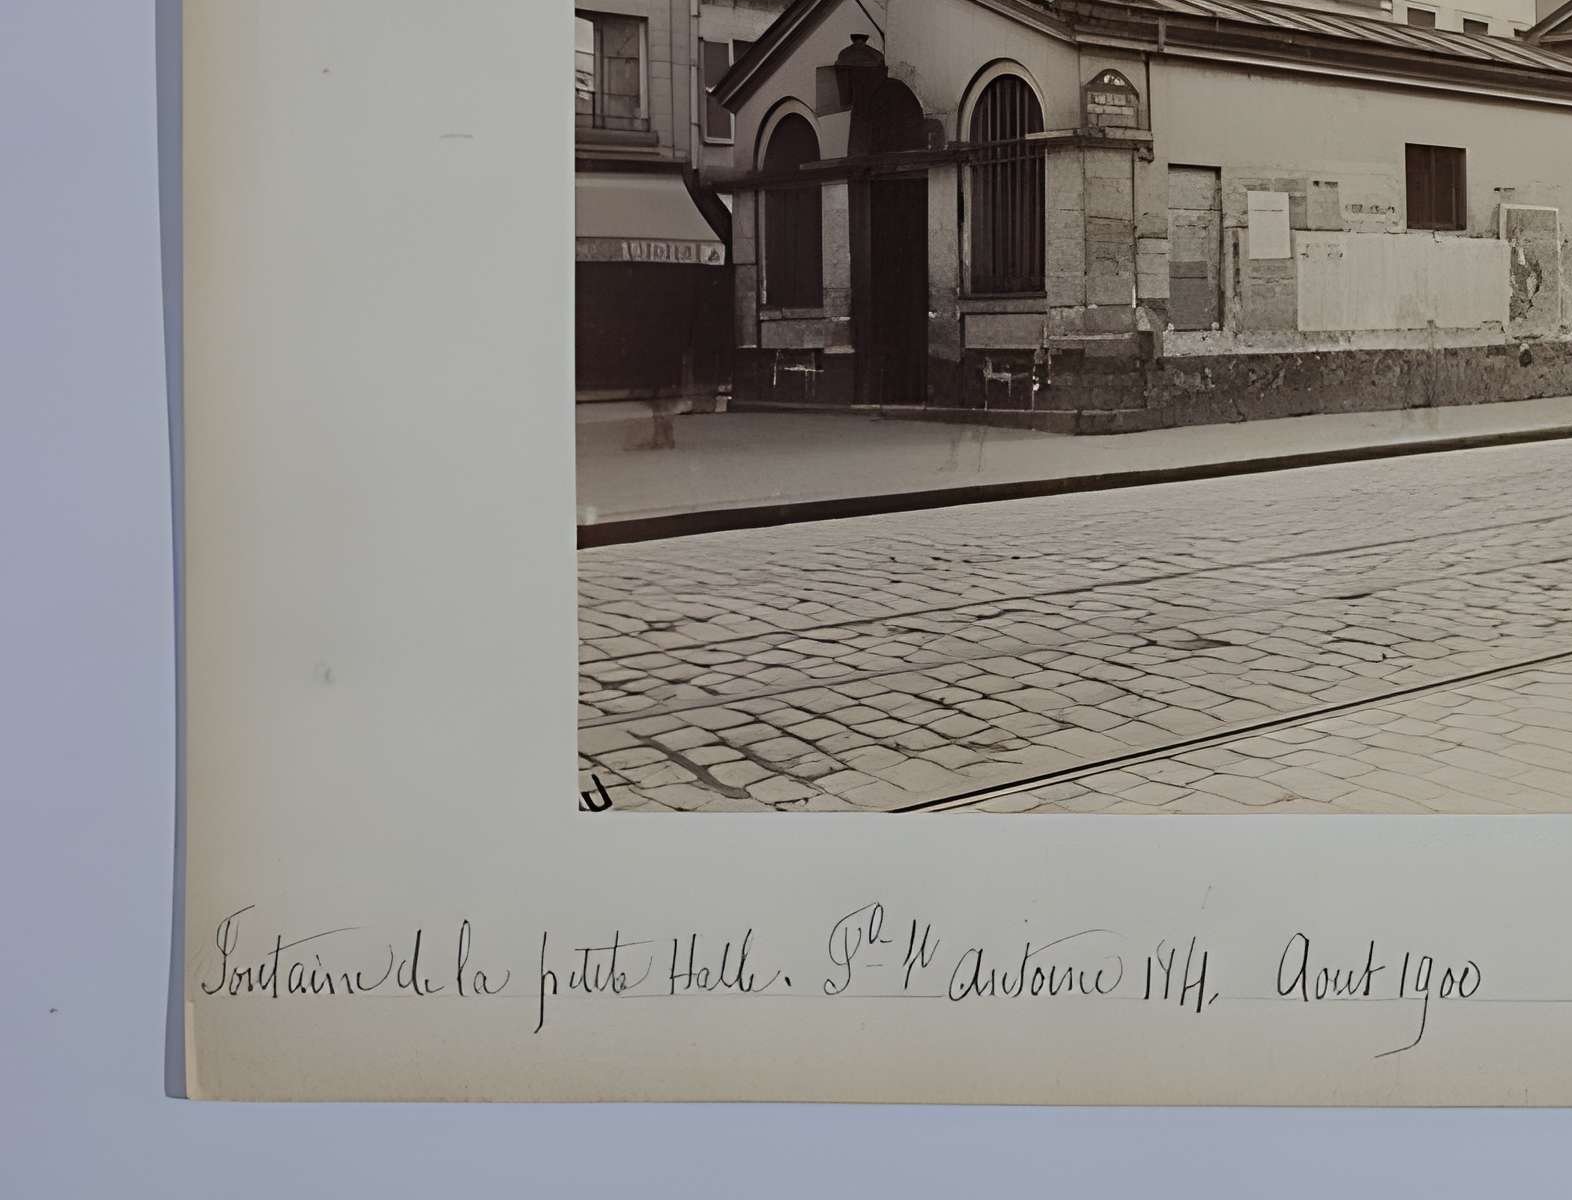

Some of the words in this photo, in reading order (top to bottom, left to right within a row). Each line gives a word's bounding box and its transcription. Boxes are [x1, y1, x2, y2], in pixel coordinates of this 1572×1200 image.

[397, 927, 445, 995] de
[455, 919, 512, 995] la
[1374, 951, 1482, 1058] 1900
